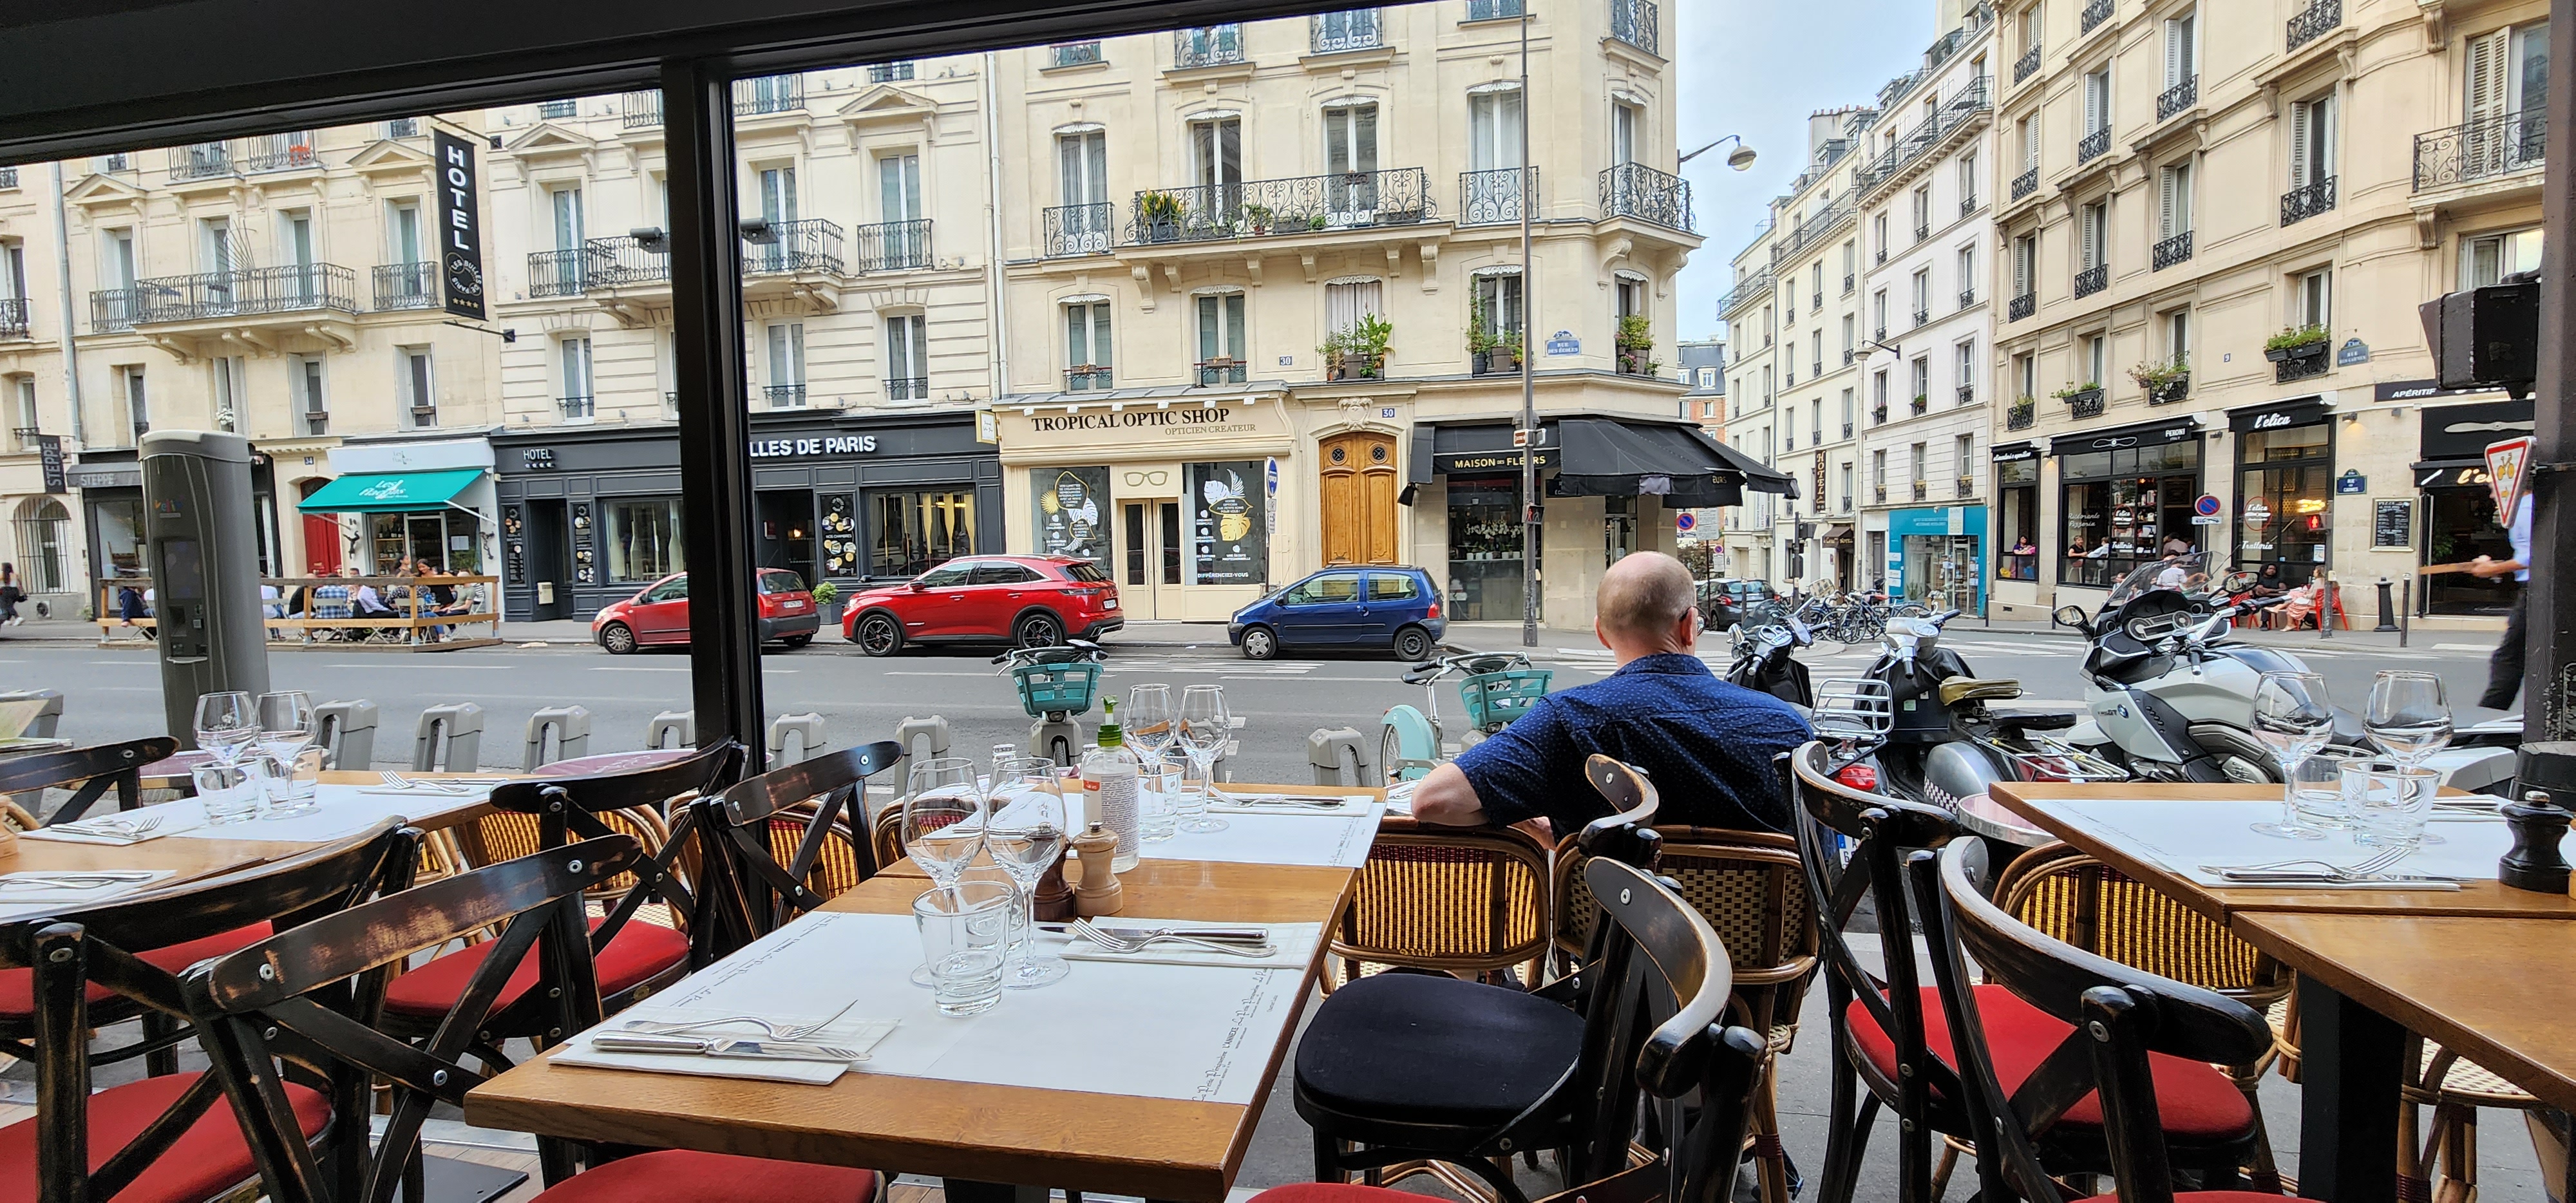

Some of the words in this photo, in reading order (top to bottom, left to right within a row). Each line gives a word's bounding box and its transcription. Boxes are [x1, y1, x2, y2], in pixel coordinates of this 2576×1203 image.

[448, 144, 469, 251] HOTEL
[451, 258, 463, 272] LES
[464, 260, 482, 285] BULLES
[451, 276, 470, 294] PARIS
[1280, 357, 1291, 365] 30
[2392, 387, 2437, 398] APÉRITIF
[1032, 413, 1120, 431] TROPICAL
[1123, 411, 1177, 428] OPTIC
[1182, 408, 1229, 424] SHOP
[1383, 409, 1394, 417] 30
[1165, 426, 1207, 435] OPTICIEN
[1208, 424, 1256, 433] CREATEUR
[2165, 428, 2186, 437] PERONI
[750, 440, 793, 457] LLES
[797, 439, 821, 455] DE
[826, 436, 876, 453] PARIS
[523, 449, 552, 460] HOTEL
[43, 442, 62, 486] STEPPE
[1455, 458, 1495, 468] MAISON
[1506, 456, 1546, 466] FLERS
[80, 473, 115, 486] STEPPE
[1817, 451, 1825, 495] HOTEL
[2242, 540, 2273, 549] Trattoria
